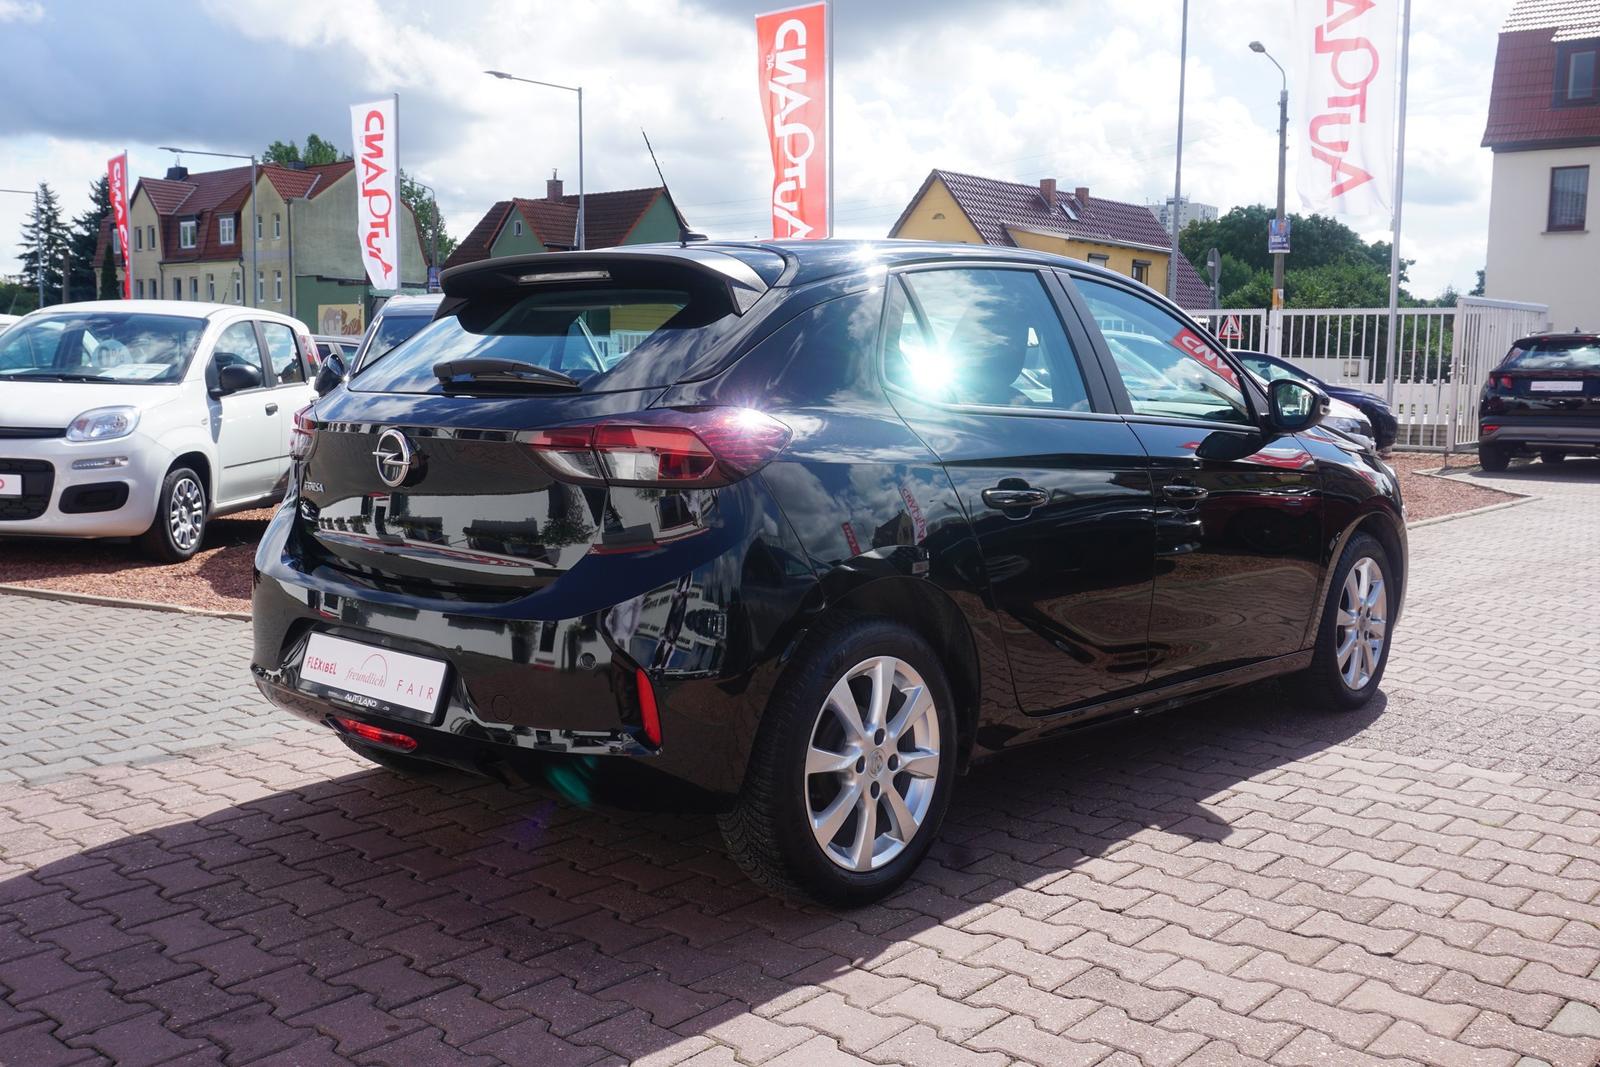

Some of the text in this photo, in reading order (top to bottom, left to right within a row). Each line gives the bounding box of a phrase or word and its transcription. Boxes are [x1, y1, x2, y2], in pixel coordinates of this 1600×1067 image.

[305, 656, 435, 701] FLEXIBEL freundlich FAIR
